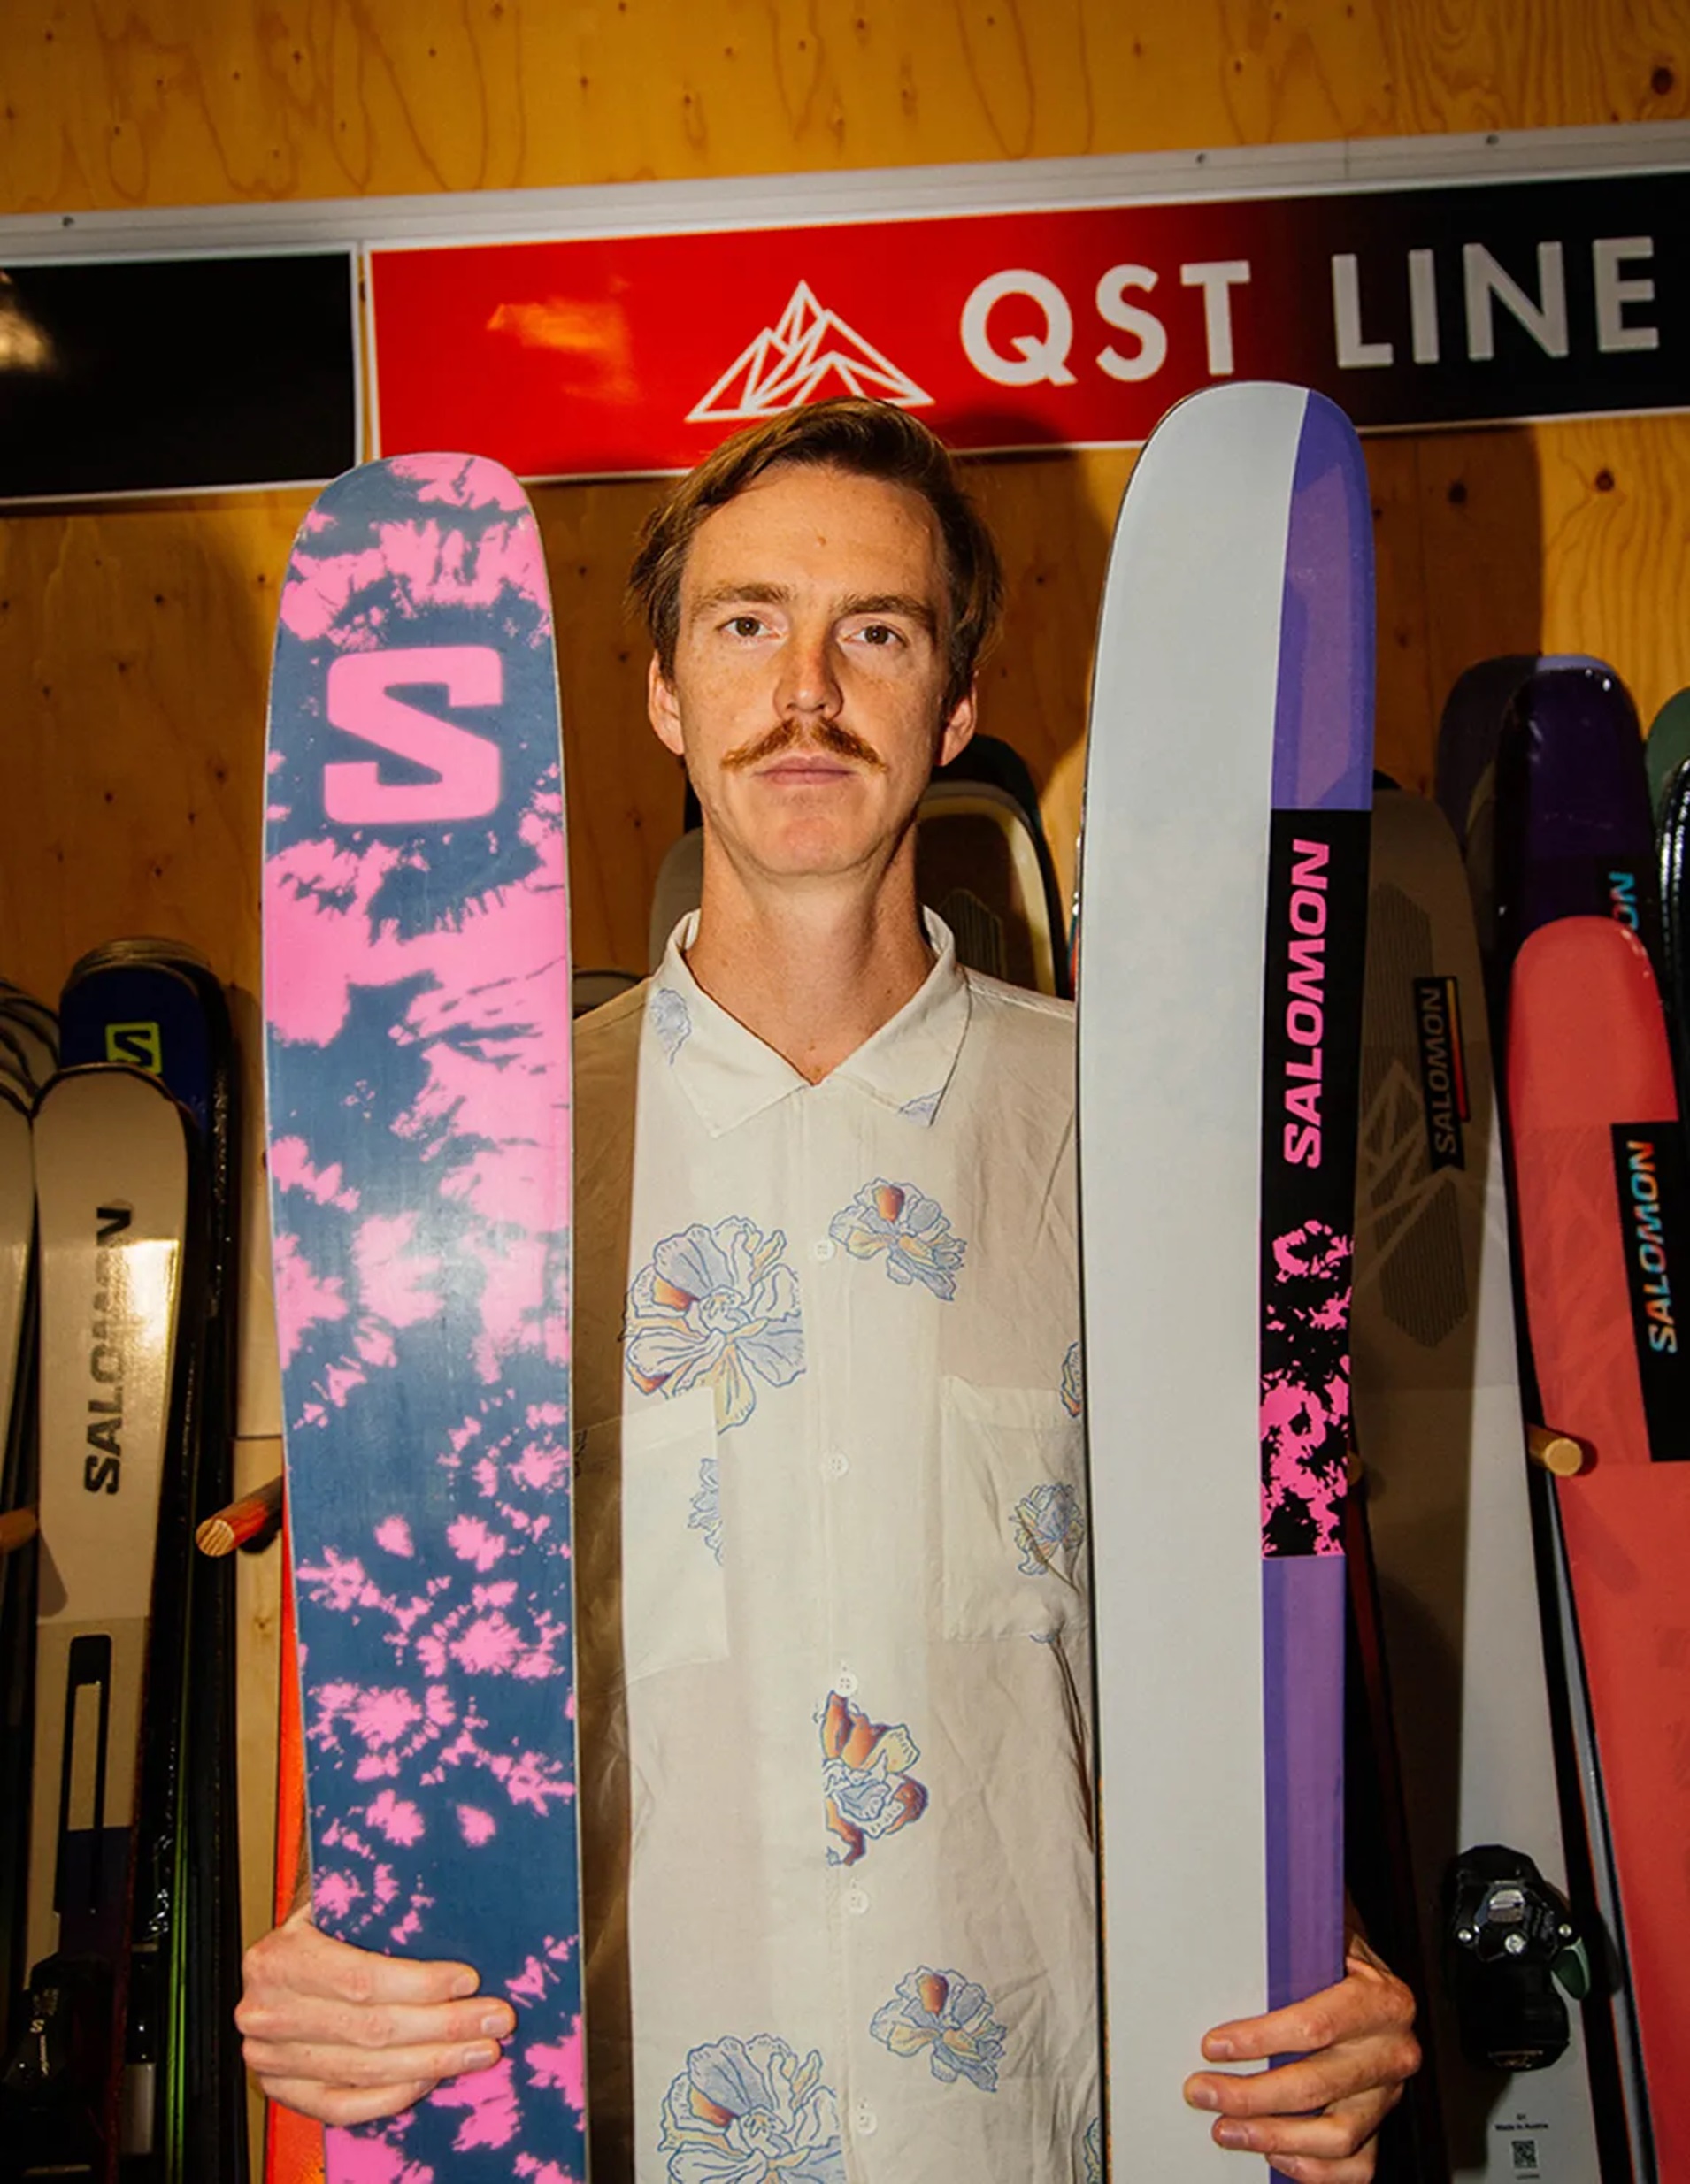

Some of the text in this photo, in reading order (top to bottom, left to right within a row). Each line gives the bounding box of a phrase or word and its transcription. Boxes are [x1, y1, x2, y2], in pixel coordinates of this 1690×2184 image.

[960, 236, 1659, 387] QST LINE
[324, 645, 503, 824] S
[1283, 839, 1330, 1169] SALOMON
[1421, 986, 1457, 1154] SALOMON
[1626, 1140, 1678, 1354] SALOMON
